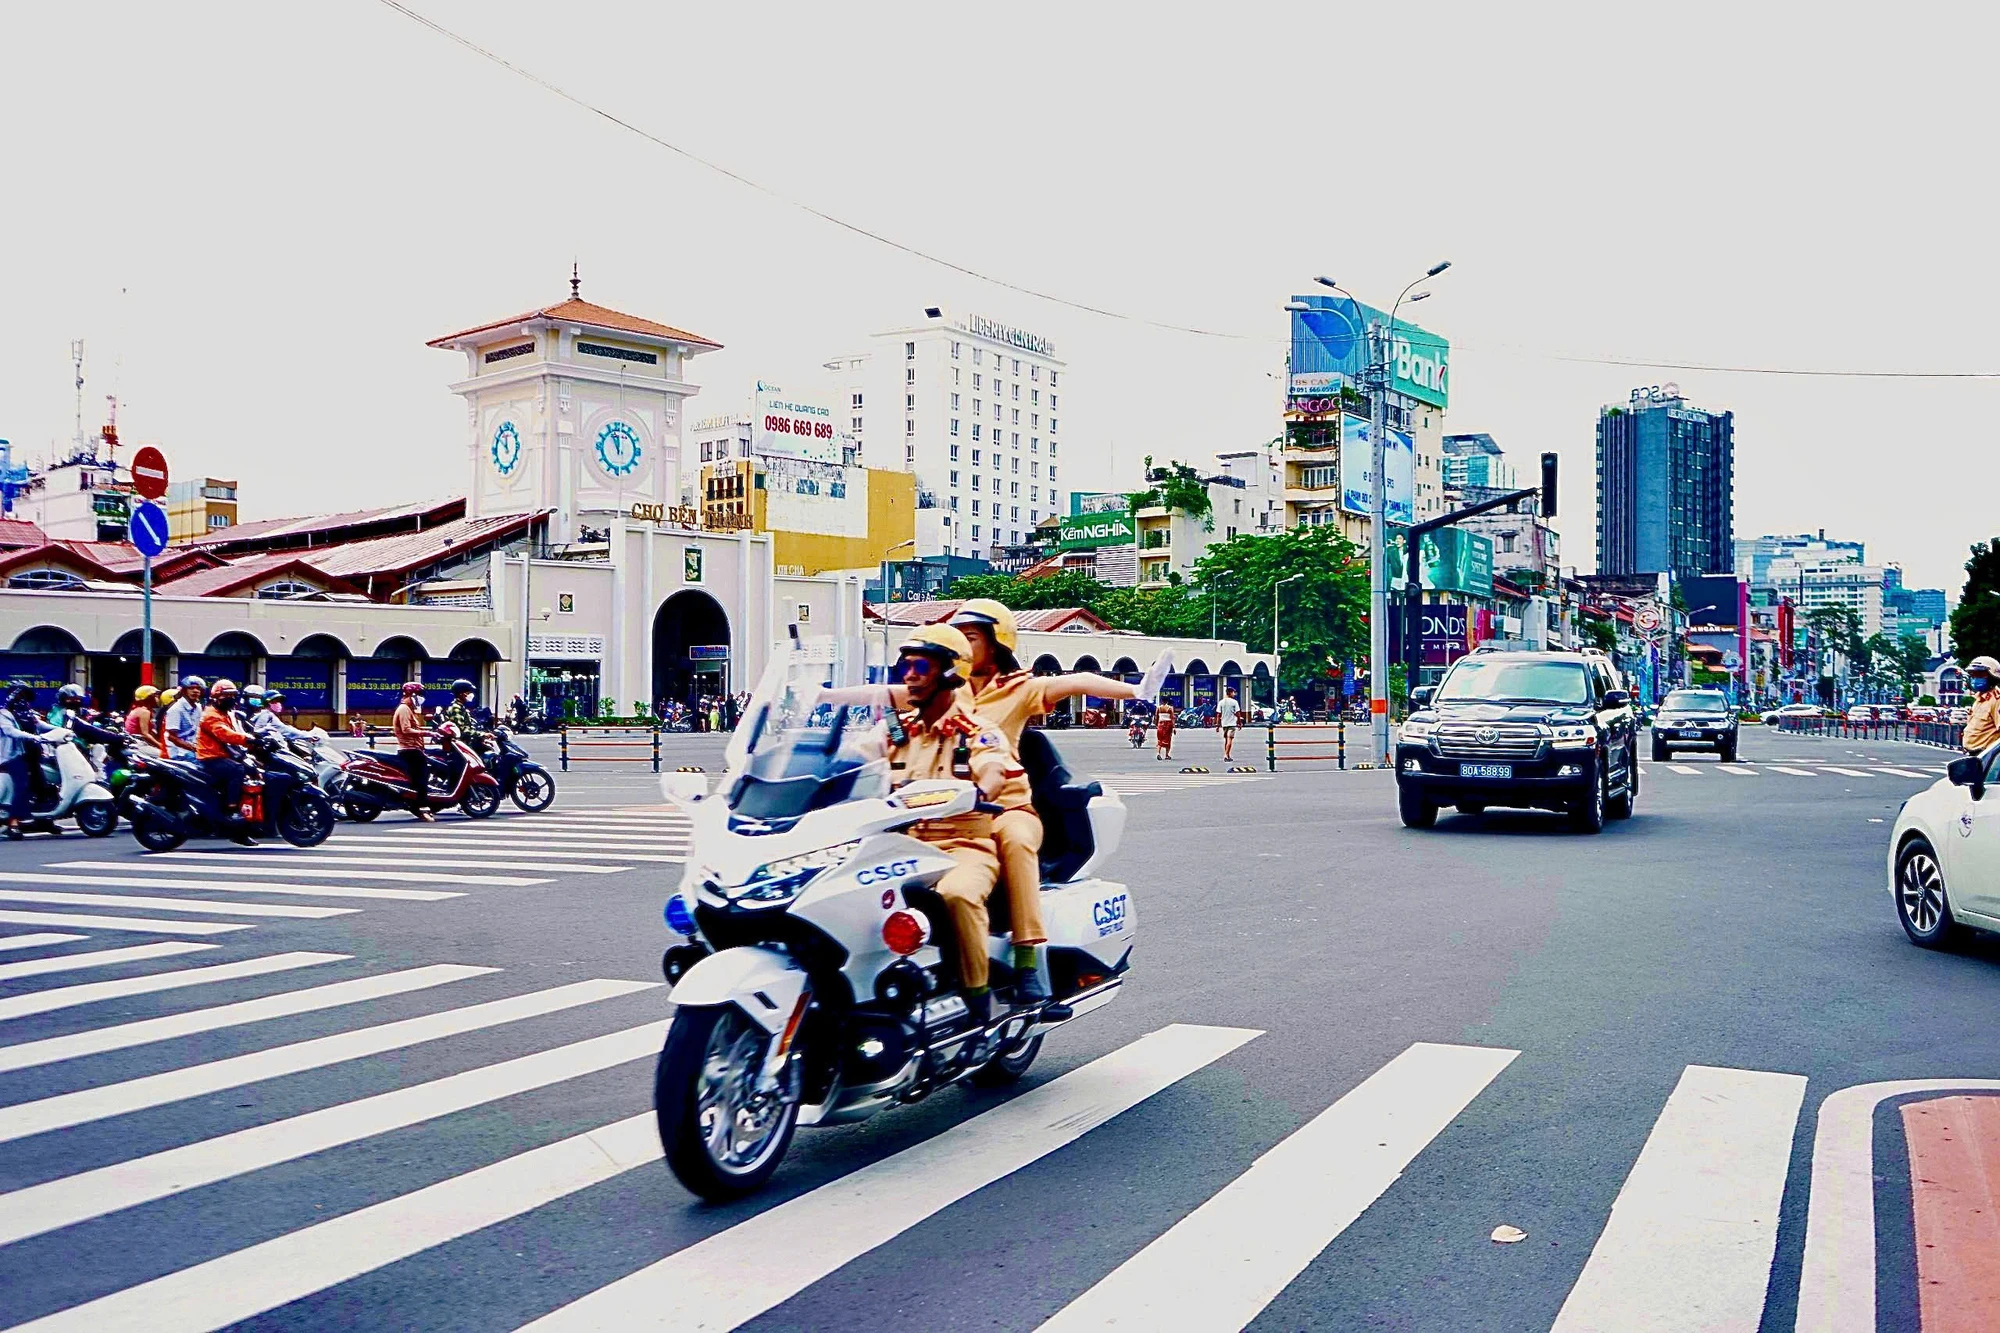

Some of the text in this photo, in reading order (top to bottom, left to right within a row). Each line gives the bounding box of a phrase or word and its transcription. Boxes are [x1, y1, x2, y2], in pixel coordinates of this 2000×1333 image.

[765, 414, 834, 440] 0986 669 689
[632, 503, 664, 521] CHỢ
[856, 859, 919, 886] CSGT
[1093, 894, 1126, 926] CSGT
